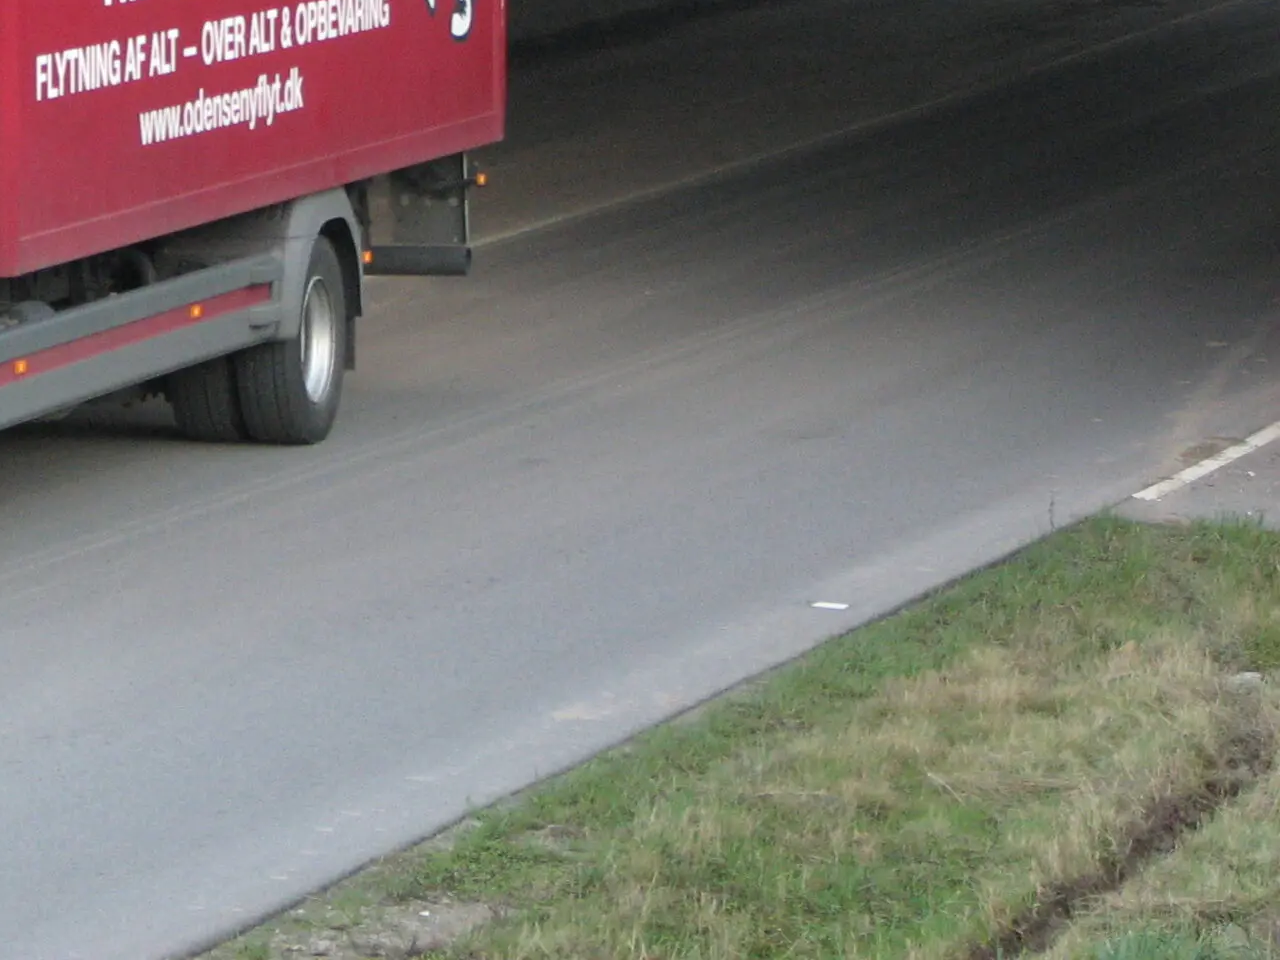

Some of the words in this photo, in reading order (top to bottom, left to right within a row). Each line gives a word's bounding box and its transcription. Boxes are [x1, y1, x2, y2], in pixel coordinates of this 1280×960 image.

[35, 40, 122, 101] FLYTNING
[124, 35, 147, 82] AF
[149, 28, 179, 77] ALT
[201, 15, 246, 66] OVER
[249, 7, 279, 56] ALT
[280, 10, 293, 49] &
[139, 67, 305, 145] www.odensenyflyt.dk
